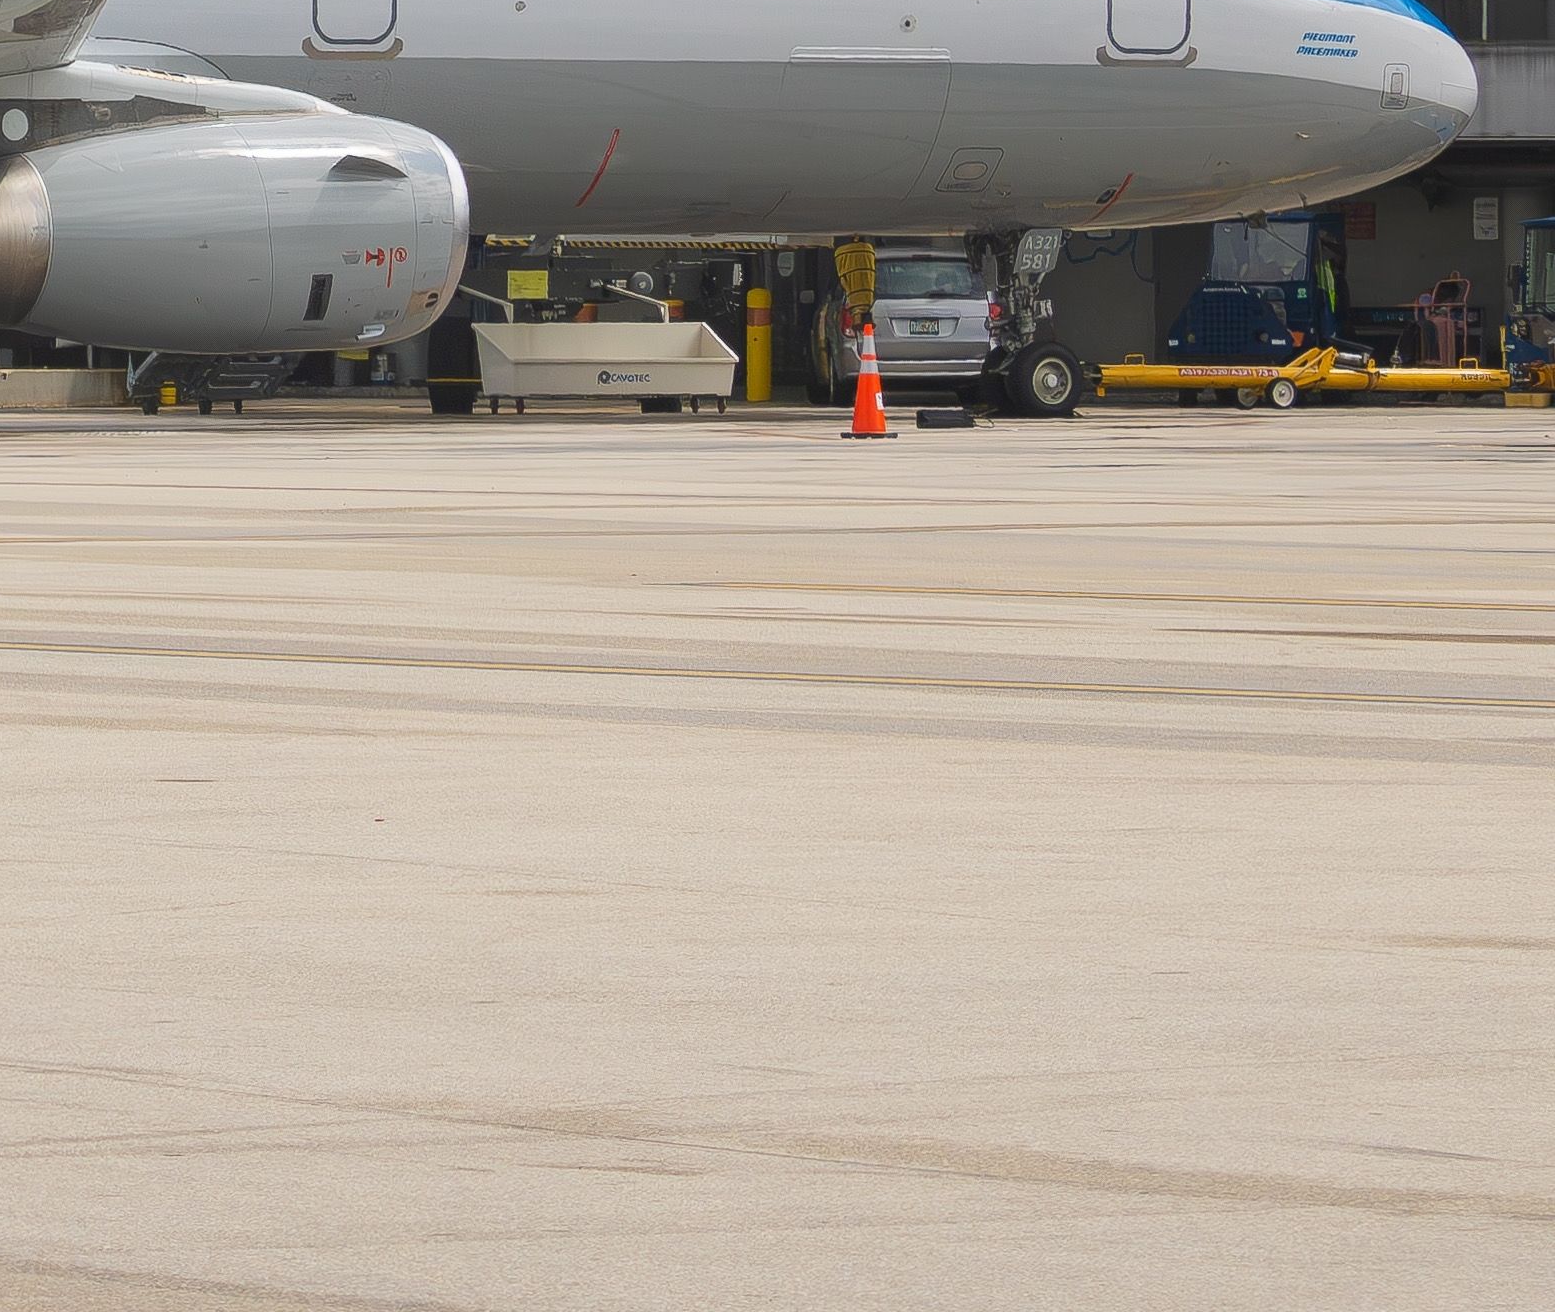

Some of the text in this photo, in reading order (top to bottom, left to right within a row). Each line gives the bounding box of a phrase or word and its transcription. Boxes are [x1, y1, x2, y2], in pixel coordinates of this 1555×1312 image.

[1302, 32, 1356, 44] PIEDMONT
[1296, 45, 1359, 58] PACEMAKER
[1025, 235, 1058, 249] A321
[1021, 253, 1051, 270] 581
[610, 373, 652, 383] CAVOTEC
